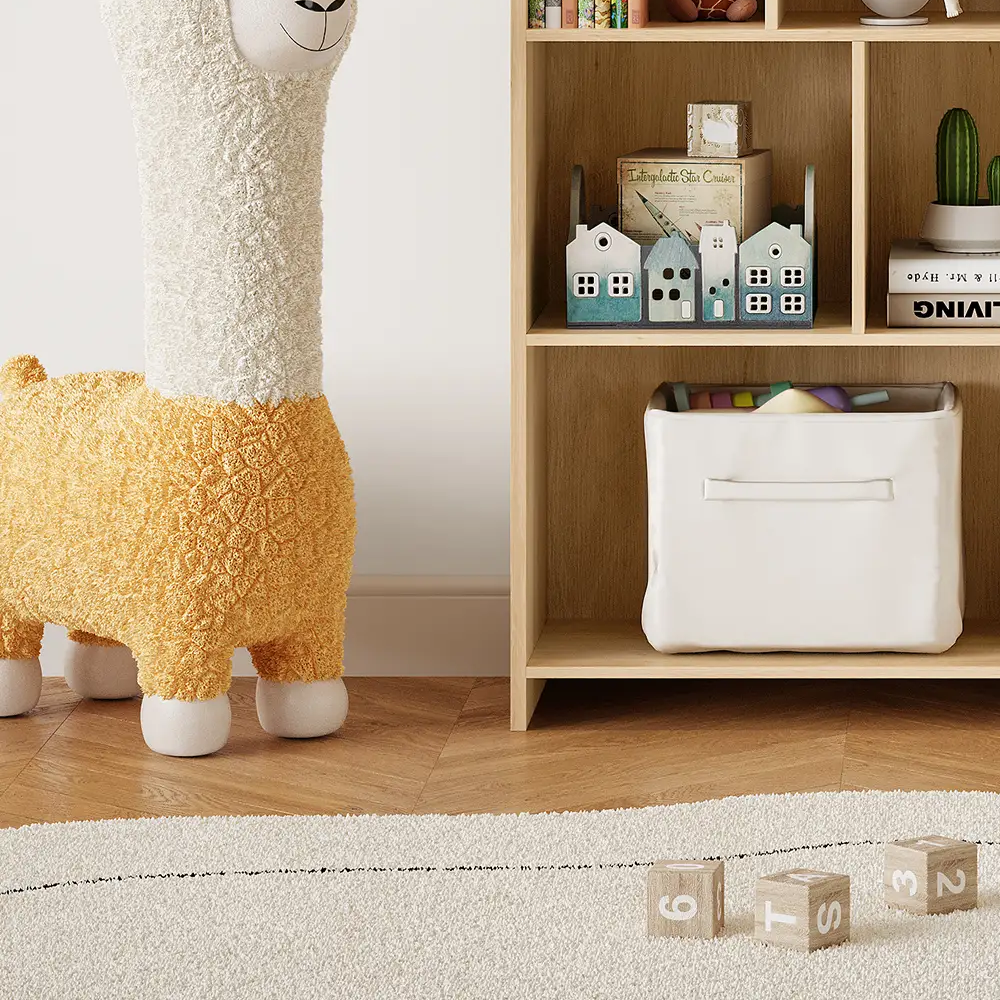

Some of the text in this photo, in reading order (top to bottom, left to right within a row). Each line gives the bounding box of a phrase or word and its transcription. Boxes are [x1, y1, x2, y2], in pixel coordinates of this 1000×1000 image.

[627, 168, 736, 188] Intergalactic Star Cruiser
[892, 869, 917, 897] 3
[937, 869, 967, 898] 2
[658, 894, 698, 921] 6
[764, 900, 797, 933] T
[816, 900, 842, 935] S
